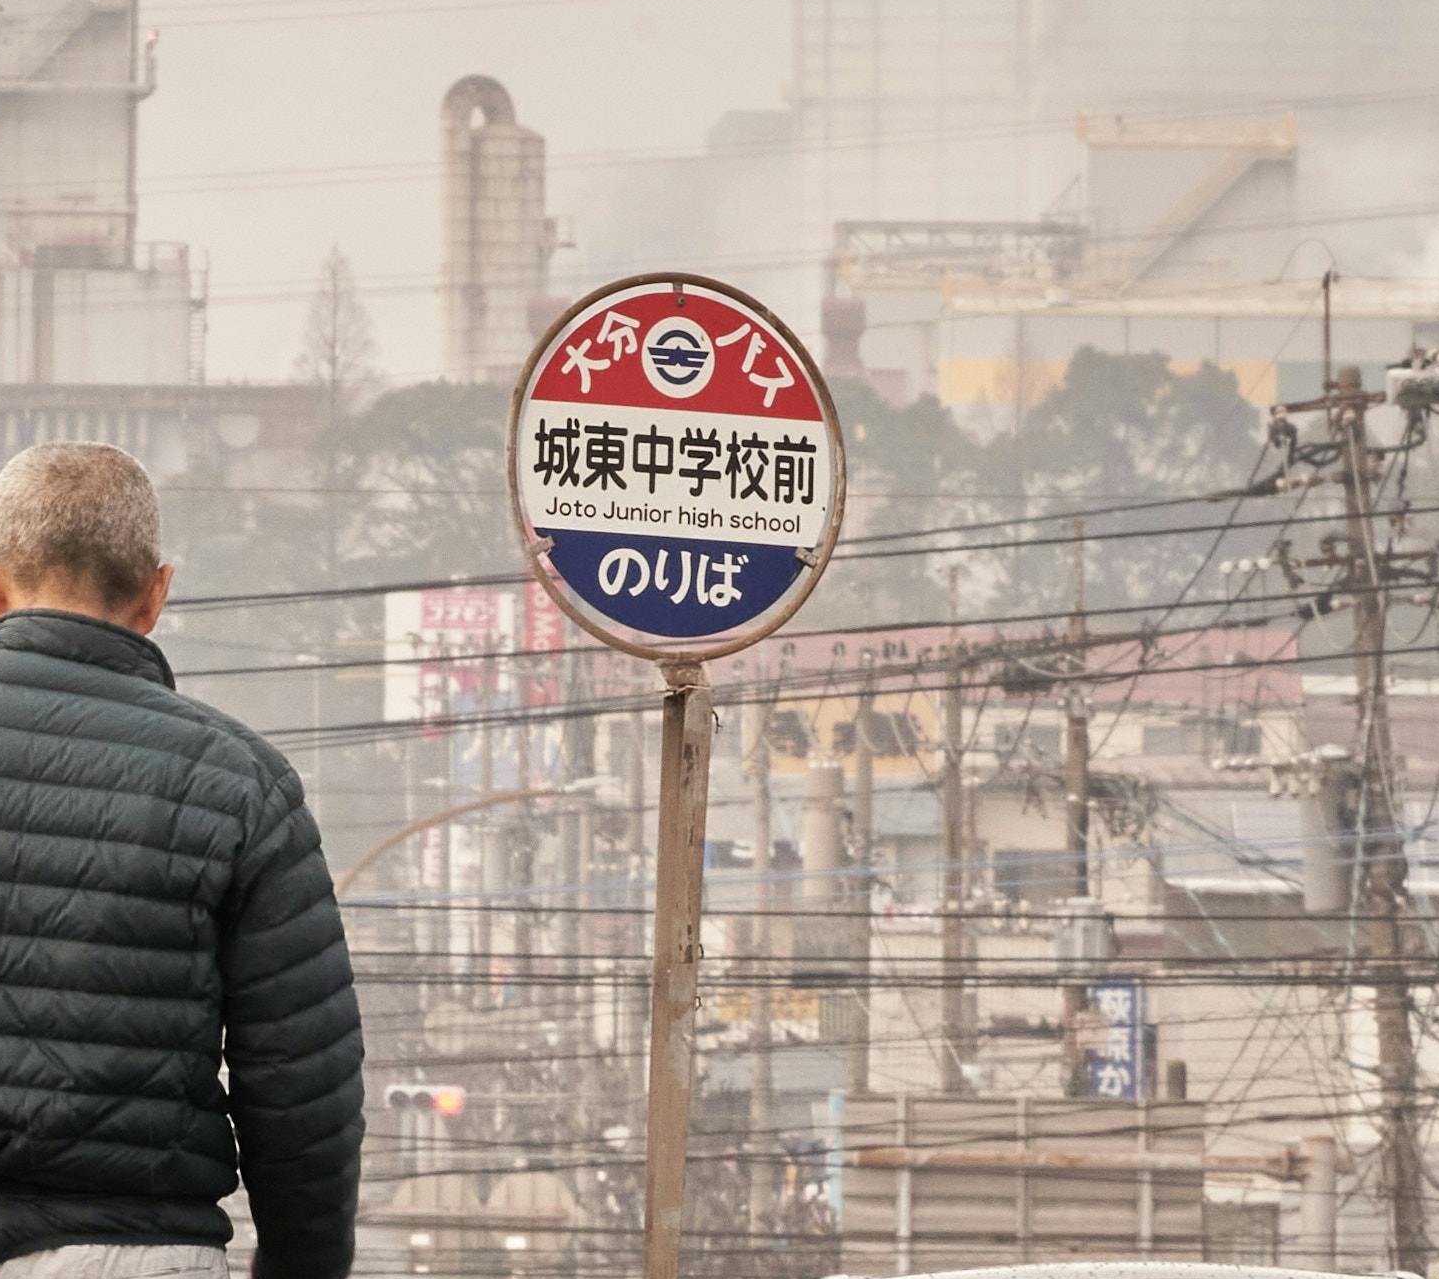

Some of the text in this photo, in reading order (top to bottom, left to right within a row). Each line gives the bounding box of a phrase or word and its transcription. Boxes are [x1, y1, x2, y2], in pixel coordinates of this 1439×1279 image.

[561, 310, 796, 408] 大分 バス
[533, 417, 817, 505] 城東中学校前
[545, 496, 801, 534] Joto Junior high school
[598, 546, 749, 608] のりば
